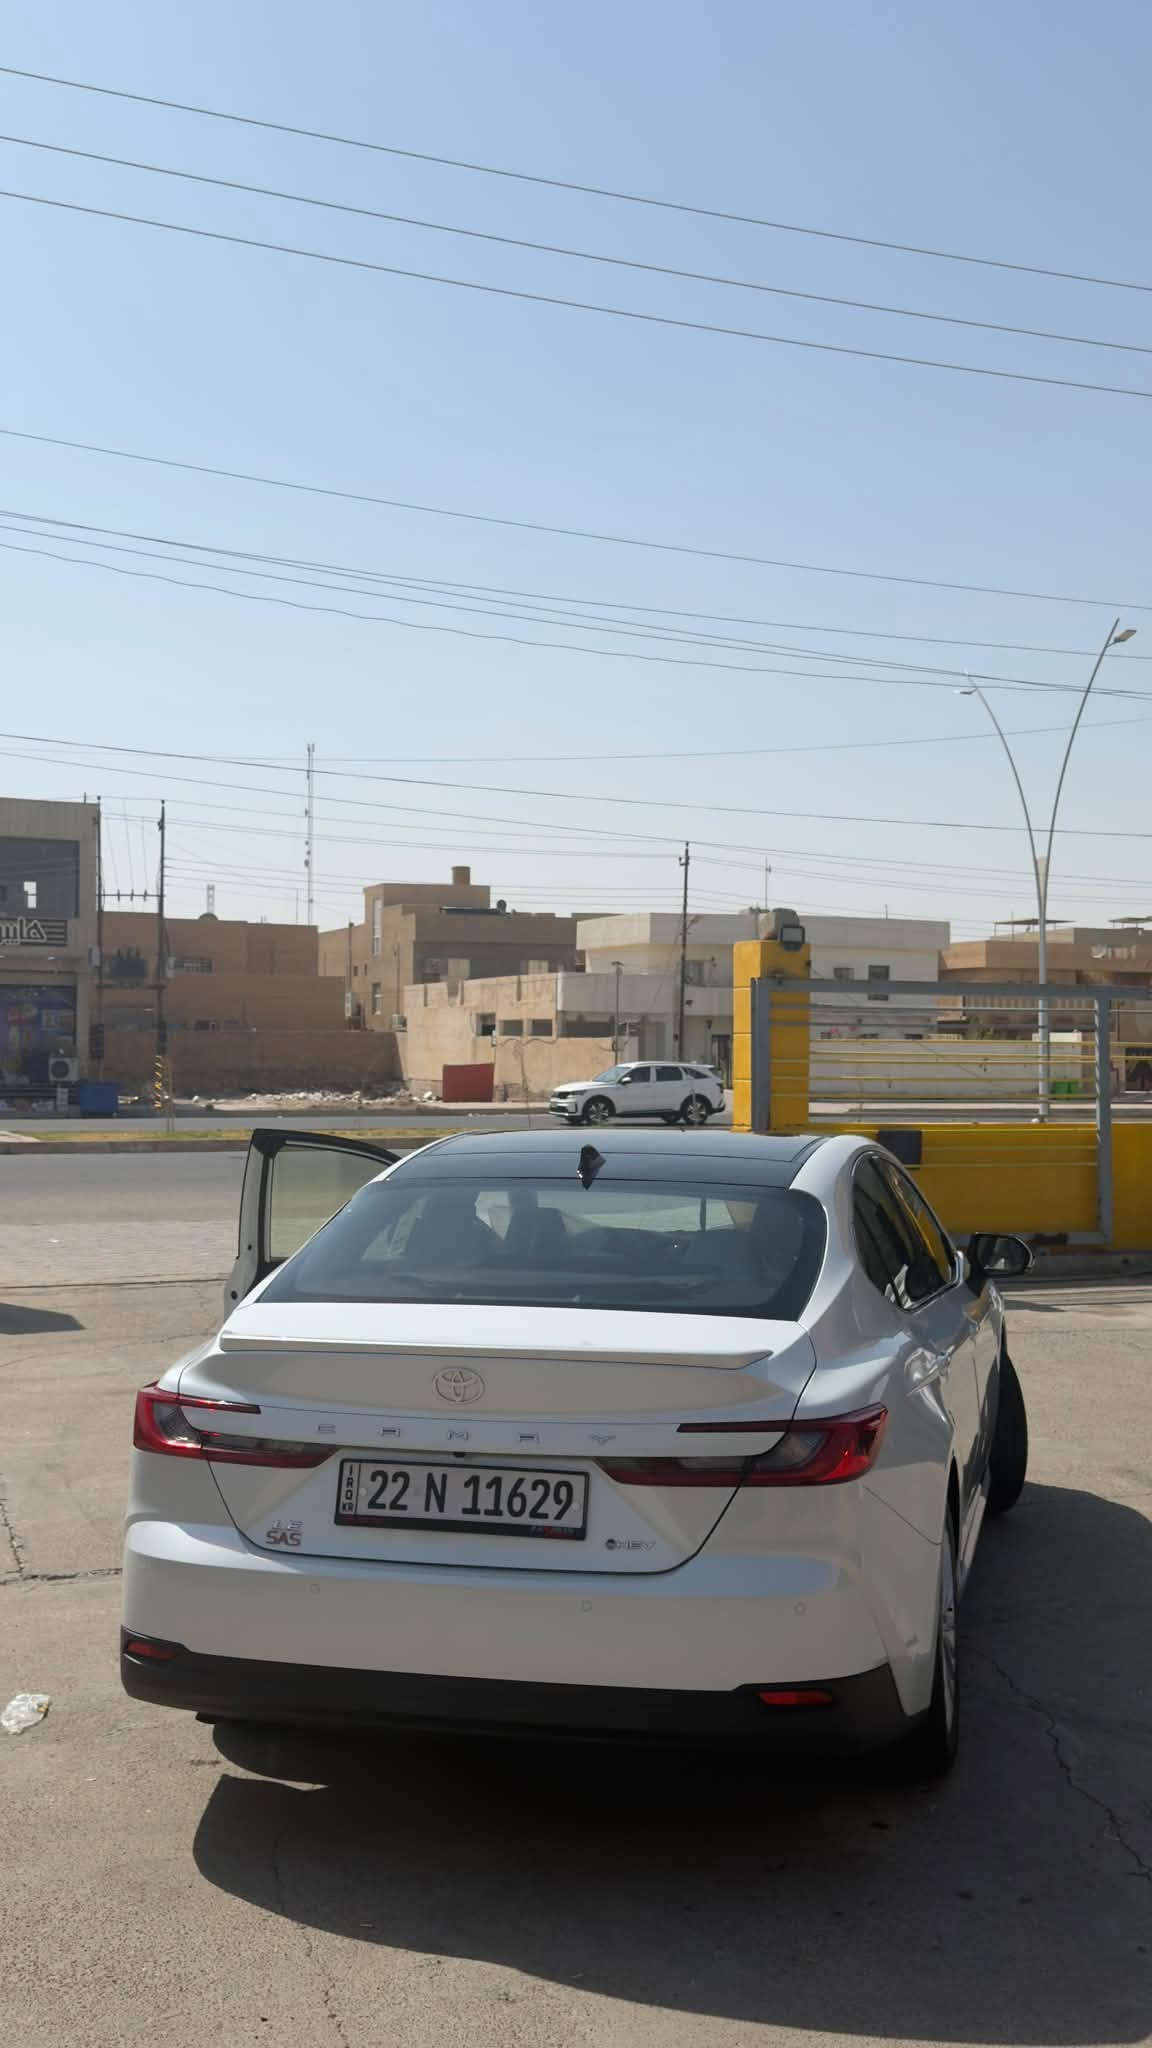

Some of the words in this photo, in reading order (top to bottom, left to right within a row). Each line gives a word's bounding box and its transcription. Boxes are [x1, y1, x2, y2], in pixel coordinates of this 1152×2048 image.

[367, 1470, 410, 1511] 22
[424, 1473, 448, 1513] N
[461, 1475, 574, 1521] 11629
[265, 1530, 302, 1546] SAS
